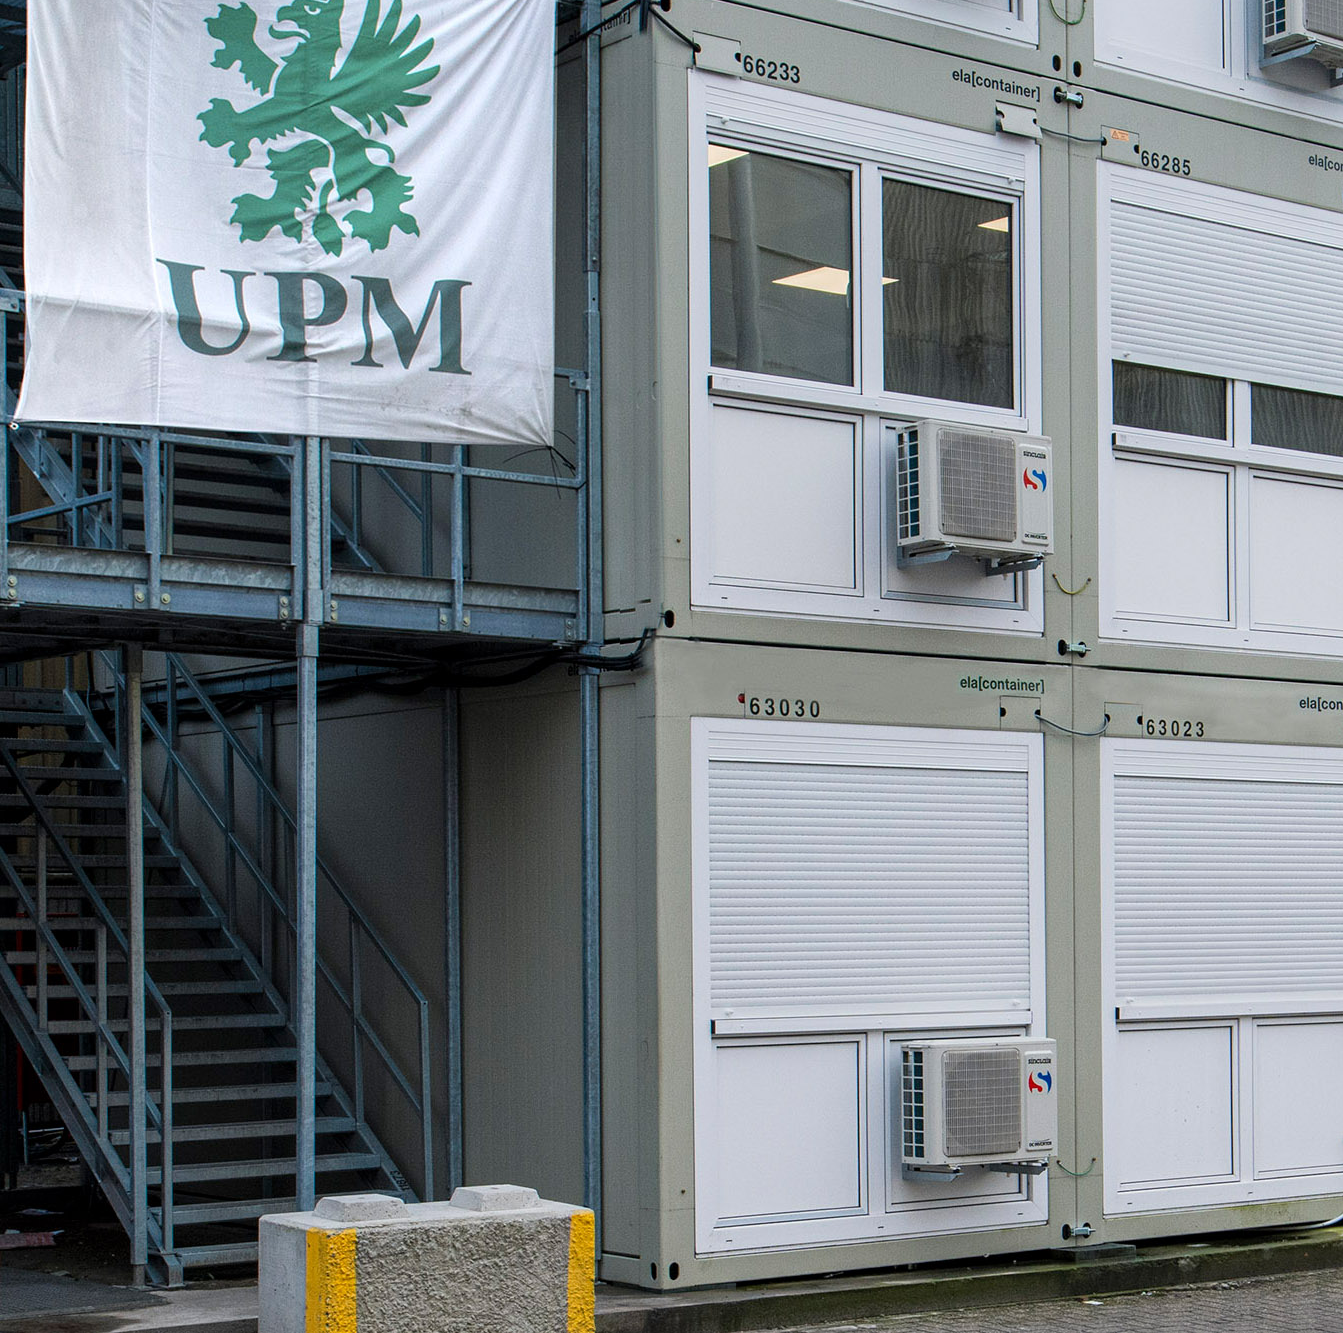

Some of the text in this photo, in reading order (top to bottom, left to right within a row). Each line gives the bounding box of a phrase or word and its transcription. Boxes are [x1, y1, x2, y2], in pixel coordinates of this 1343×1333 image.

[743, 55, 801, 84] 66233
[952, 69, 1041, 103] ela[container]
[1141, 151, 1191, 176] 66285
[155, 258, 473, 375] UPM
[960, 676, 1045, 694] ela[container]
[749, 698, 820, 718] 63030
[1146, 719, 1205, 737] 63023
